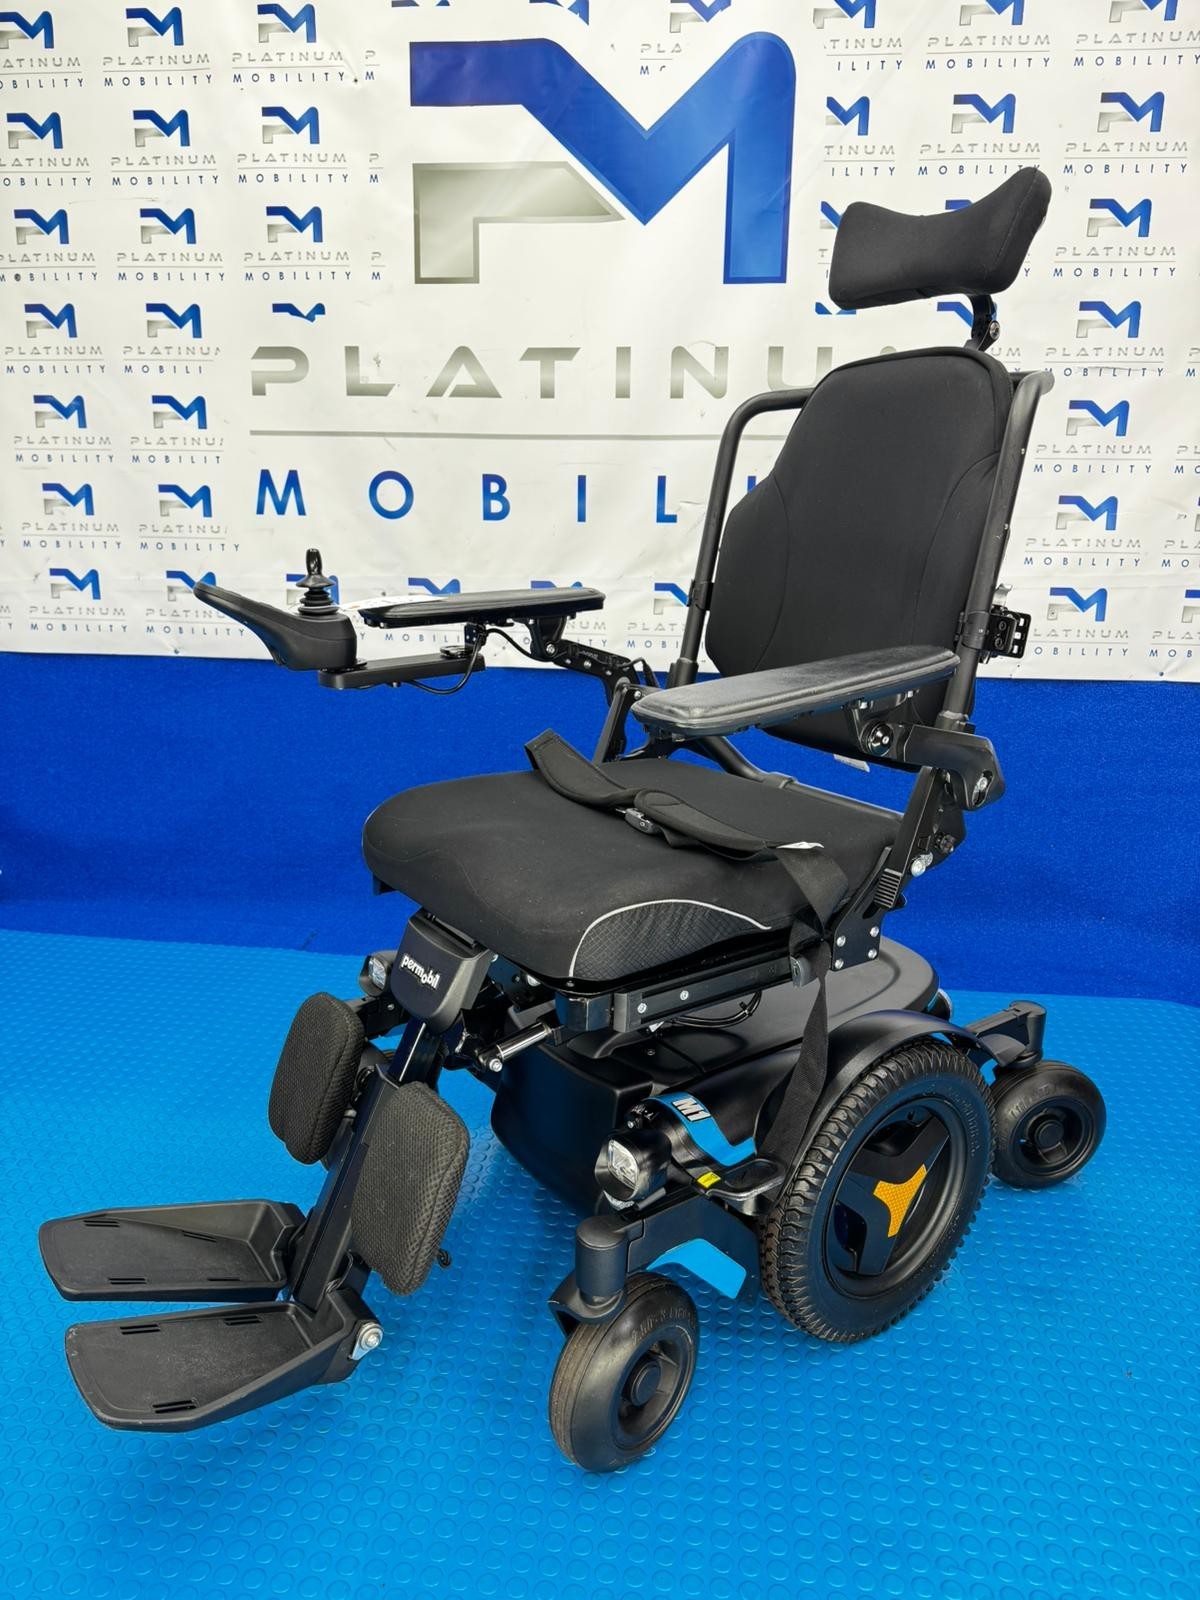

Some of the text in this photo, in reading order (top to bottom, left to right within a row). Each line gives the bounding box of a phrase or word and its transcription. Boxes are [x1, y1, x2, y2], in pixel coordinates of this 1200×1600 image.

[824, 38, 902, 49] TINUM
[928, 35, 1050, 47] PLATINUM
[103, 53, 210, 66] PLATINUM
[232, 52, 343, 62] PLATINUM
[926, 58, 1049, 69] MOBILITY
[104, 75, 212, 87] MOBILITY
[233, 72, 344, 83] MOBILITY
[920, 143, 1040, 153] PLATINUM
[1066, 142, 1187, 152] PLATINUM
[111, 155, 216, 166] PLATINUM
[237, 153, 346, 162] PLATINUM
[1063, 164, 1187, 174] MOBILITY
[112, 175, 218, 186] MOBILITY
[238, 174, 348, 183] MOBILITY
[244, 251, 349, 261] PLATINUM
[1056, 247, 1175, 256] PLATINUM
[117, 253, 222, 262] PLATINUM
[118, 272, 224, 281] MOBILITY
[245, 272, 351, 280] MOBILITY
[1053, 268, 1176, 277] MOBILITY
[5, 346, 102, 355] PLATINUM
[1046, 347, 1164, 356] PLATINUM
[7, 365, 105, 373] MOBILITY
[250, 345, 897, 400] PLATINU
[14, 436, 111, 444] PLATINUM
[1036, 445, 1151, 454] PLATINUM
[16, 455, 116, 464] MOBILITY
[1034, 464, 1151, 473] MOBILITY
[22, 522, 118, 531] PLATINUM
[139, 524, 227, 533] PLATINU
[23, 540, 121, 548] MOBILITY
[140, 542, 239, 551] MOBILITY
[1026, 538, 1140, 548] PLATINUM
[1024, 557, 1140, 568] MOBILITY
[29, 606, 126, 616] PLATINUM
[31, 623, 127, 632] MOBILITY
[147, 626, 245, 636] MOBILITY
[401, 955, 440, 988] permobil
